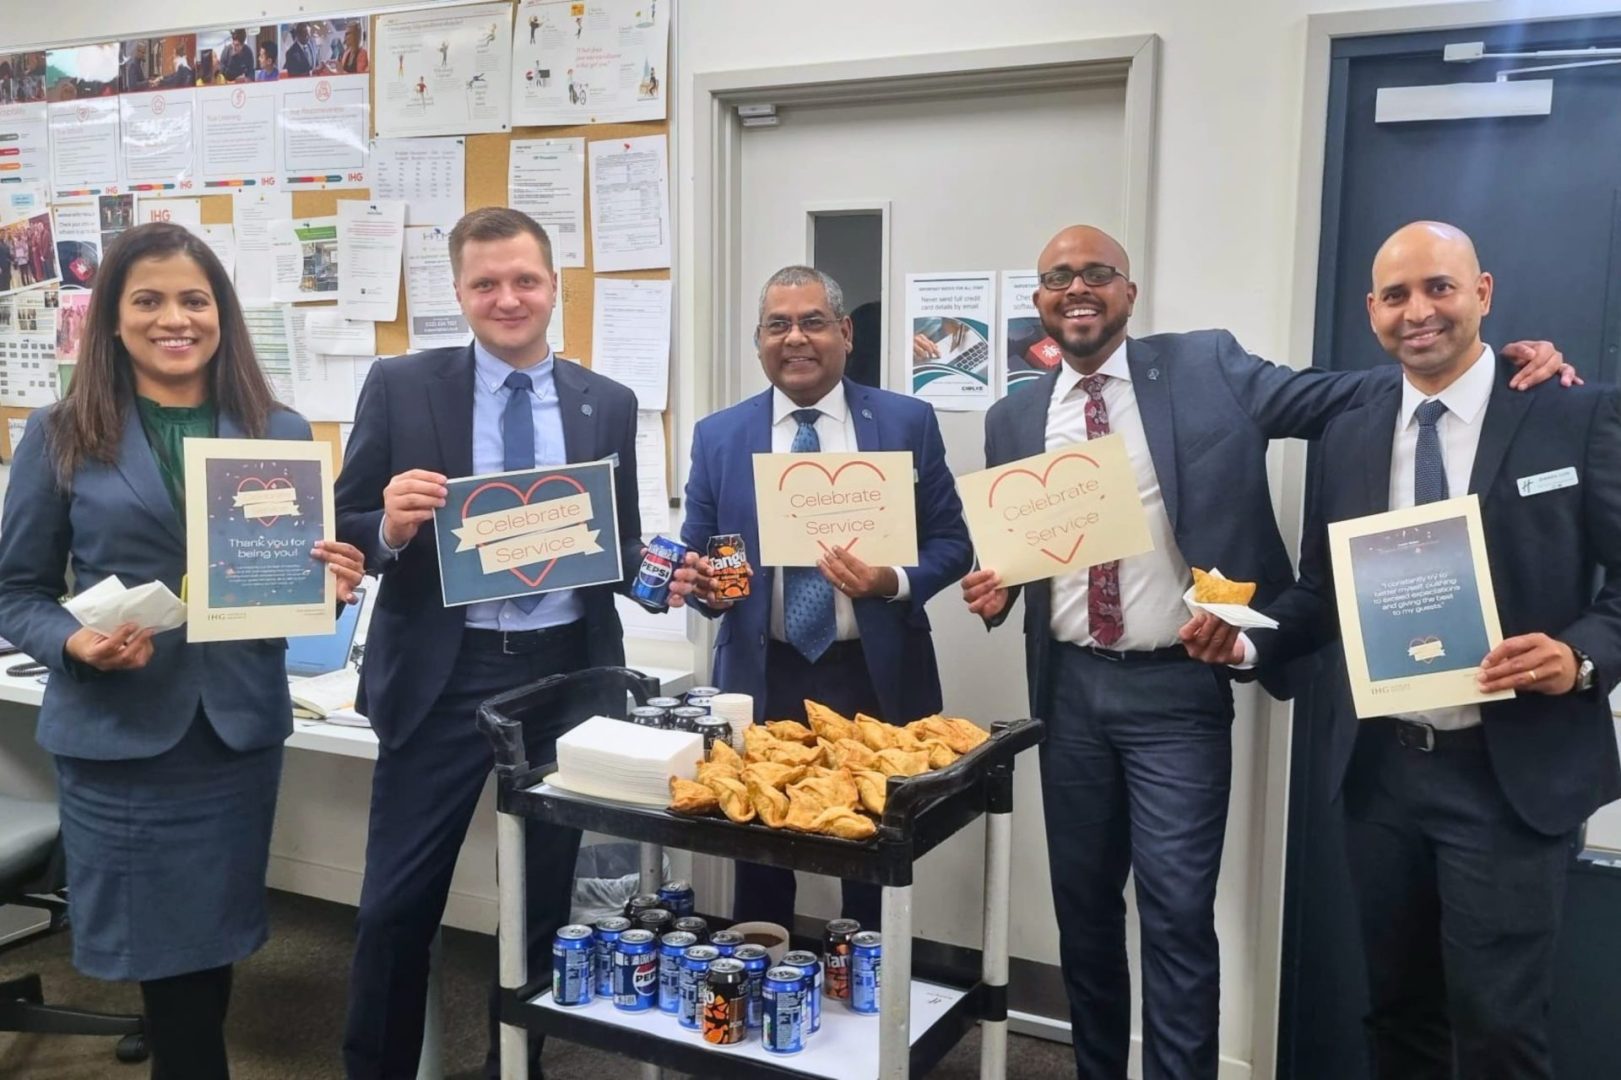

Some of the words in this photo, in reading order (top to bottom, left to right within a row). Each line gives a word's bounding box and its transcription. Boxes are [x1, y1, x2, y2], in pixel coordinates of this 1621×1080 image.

[261, 177, 275, 186] IHG
[348, 173, 363, 182] IHG
[106, 186, 118, 195] IHG
[179, 181, 193, 189] IHG
[150, 209, 171, 222] IHG
[790, 489, 881, 508] Celebrate
[1003, 479, 1100, 522] Celebrate
[476, 502, 581, 535] Celebrate
[806, 518, 875, 535] Service
[1025, 510, 1100, 546] Service
[230, 538, 265, 547] Thank
[267, 540, 288, 548] you
[290, 538, 306, 546] for
[495, 535, 575, 563] Service
[238, 549, 272, 559] being
[273, 548, 298, 559] you!
[710, 551, 746, 569] Tango
[642, 561, 669, 579] PEPSI
[1411, 585, 1461, 598] expectations
[1382, 602, 1397, 610] and
[1398, 599, 1421, 609] giving
[208, 613, 225, 621] IHG
[1371, 686, 1390, 695] IHG
